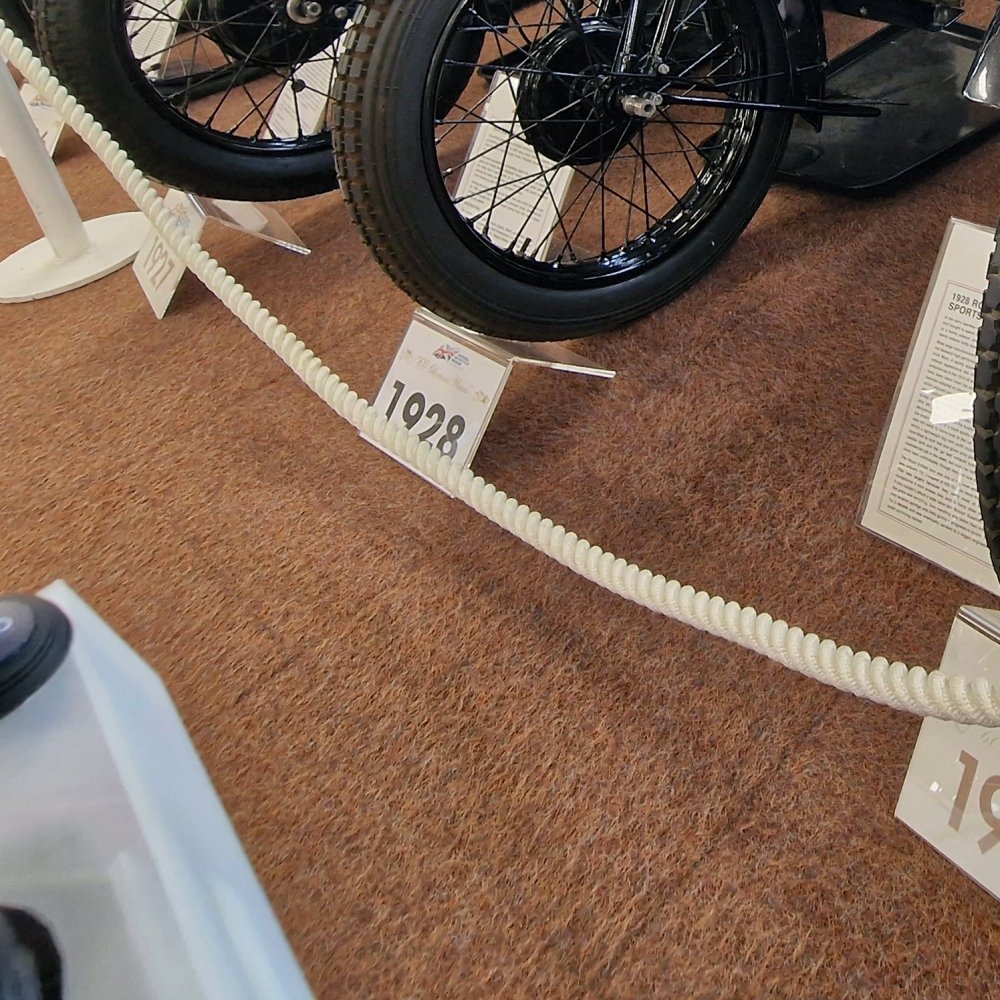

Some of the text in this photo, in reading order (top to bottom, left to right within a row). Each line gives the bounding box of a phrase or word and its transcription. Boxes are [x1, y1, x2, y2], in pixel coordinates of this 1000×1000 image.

[952, 293, 970, 305] 1928
[948, 302, 982, 321] SPORTS
[385, 380, 466, 459] 1928
